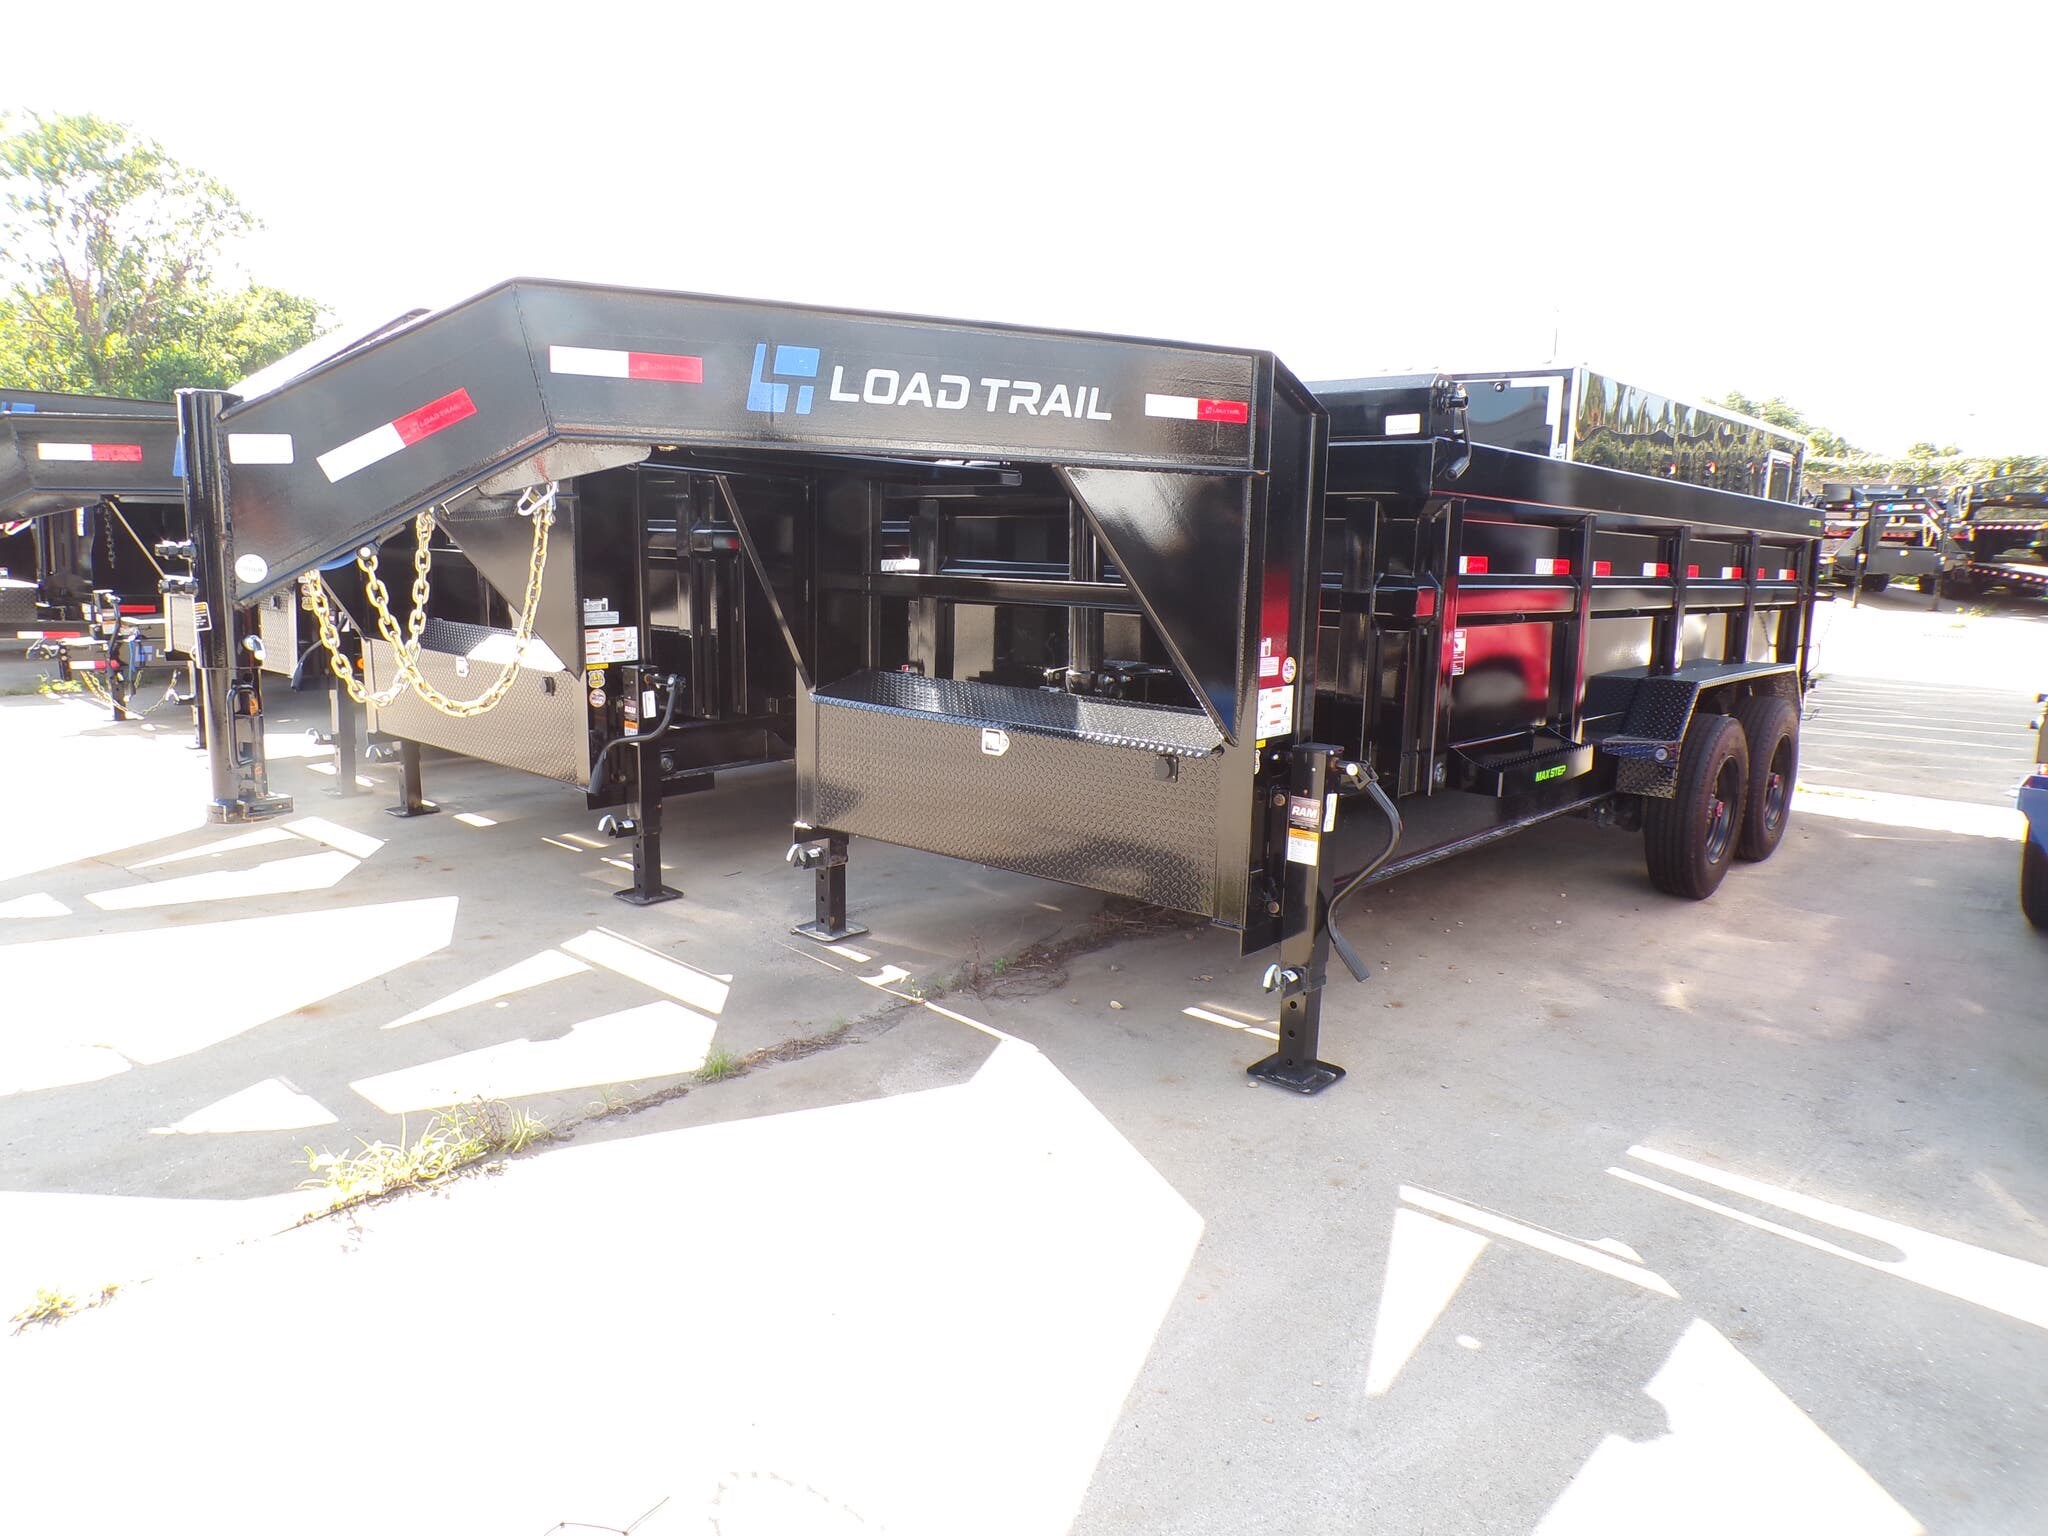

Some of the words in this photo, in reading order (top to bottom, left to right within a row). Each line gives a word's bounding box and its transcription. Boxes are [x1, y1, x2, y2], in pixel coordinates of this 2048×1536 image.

[830, 366, 971, 410] LOAD
[981, 378, 1113, 421] TRAIL
[1535, 769, 1550, 782] MAX
[1550, 764, 1567, 778] STEP
[1291, 805, 1318, 819] RAM
